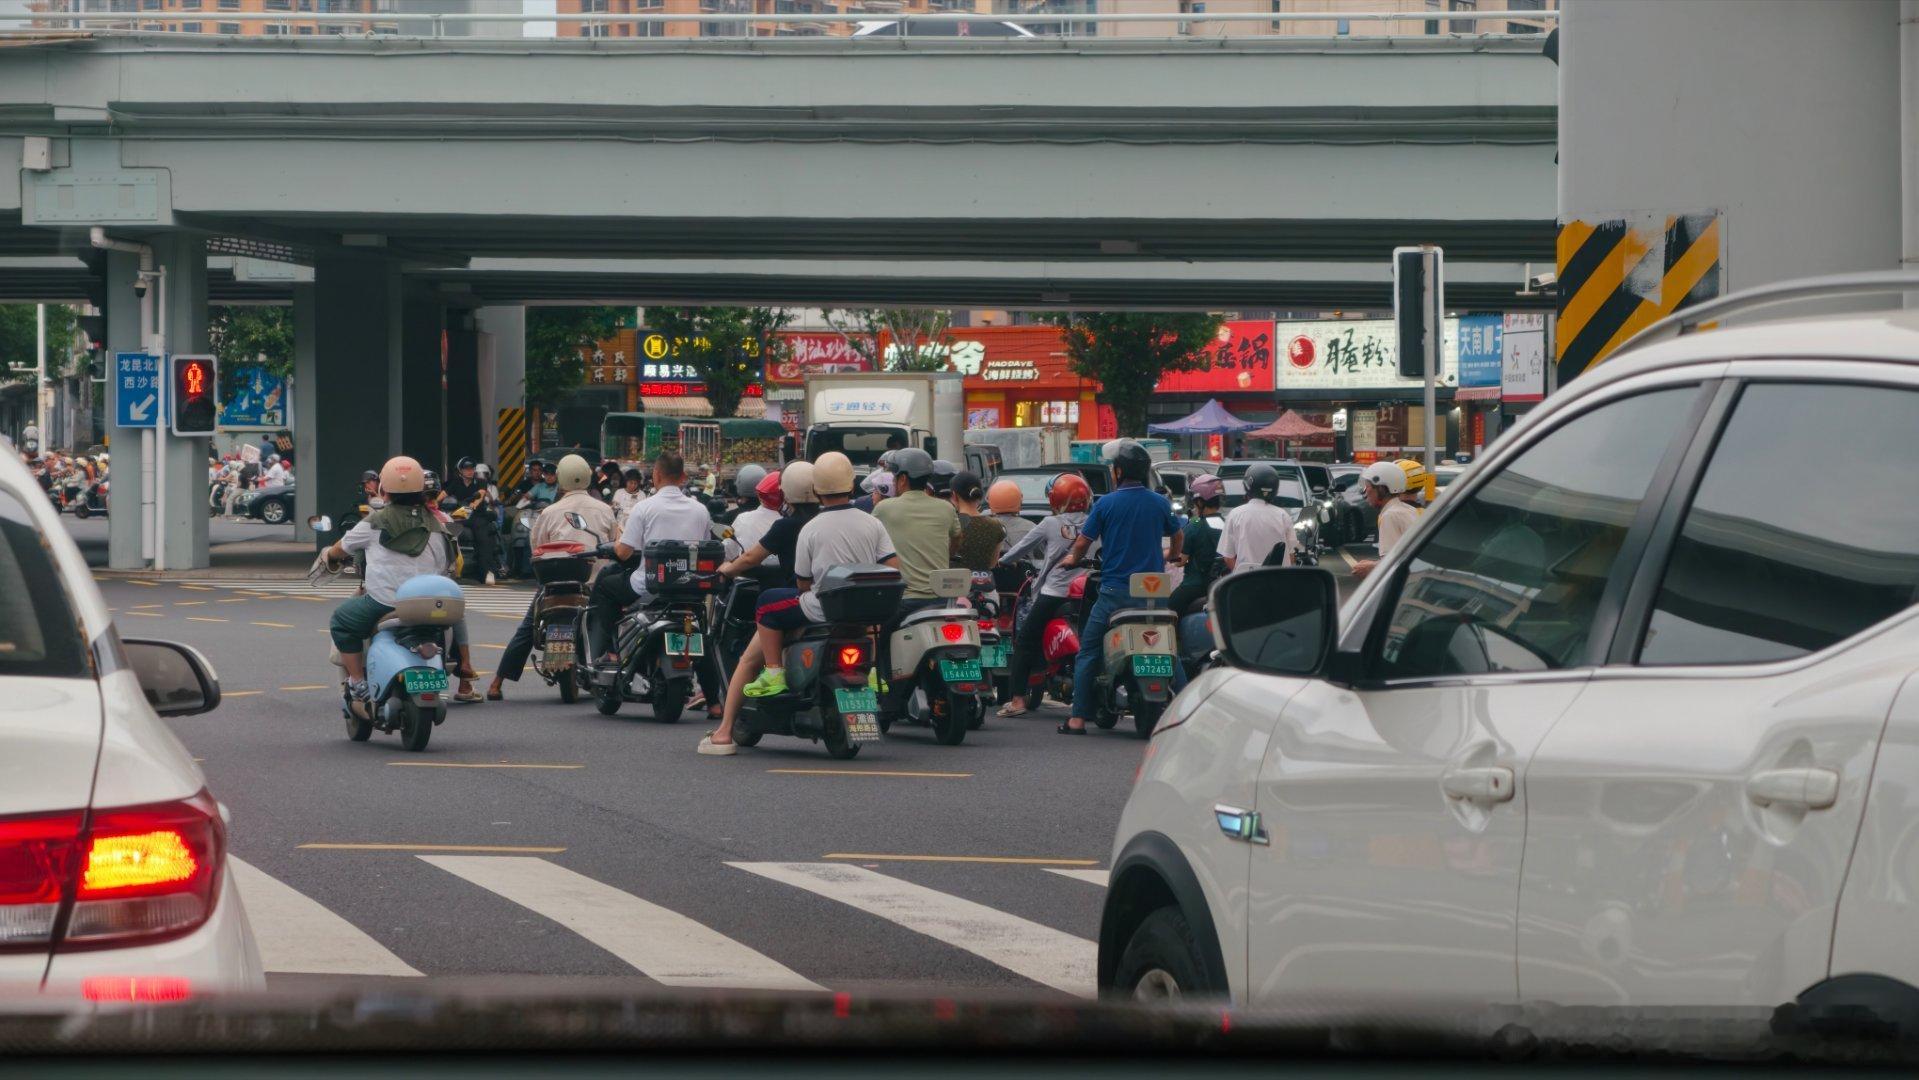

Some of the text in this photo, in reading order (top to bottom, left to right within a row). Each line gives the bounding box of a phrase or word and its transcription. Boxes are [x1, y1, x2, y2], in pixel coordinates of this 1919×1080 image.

[1324, 328, 1396, 374] 腌粉
[120, 358, 158, 371] 龙昆北
[124, 376, 159, 388] 西沙路
[831, 402, 892, 411] 宇通轻卡
[1135, 665, 1171, 674] 0972457
